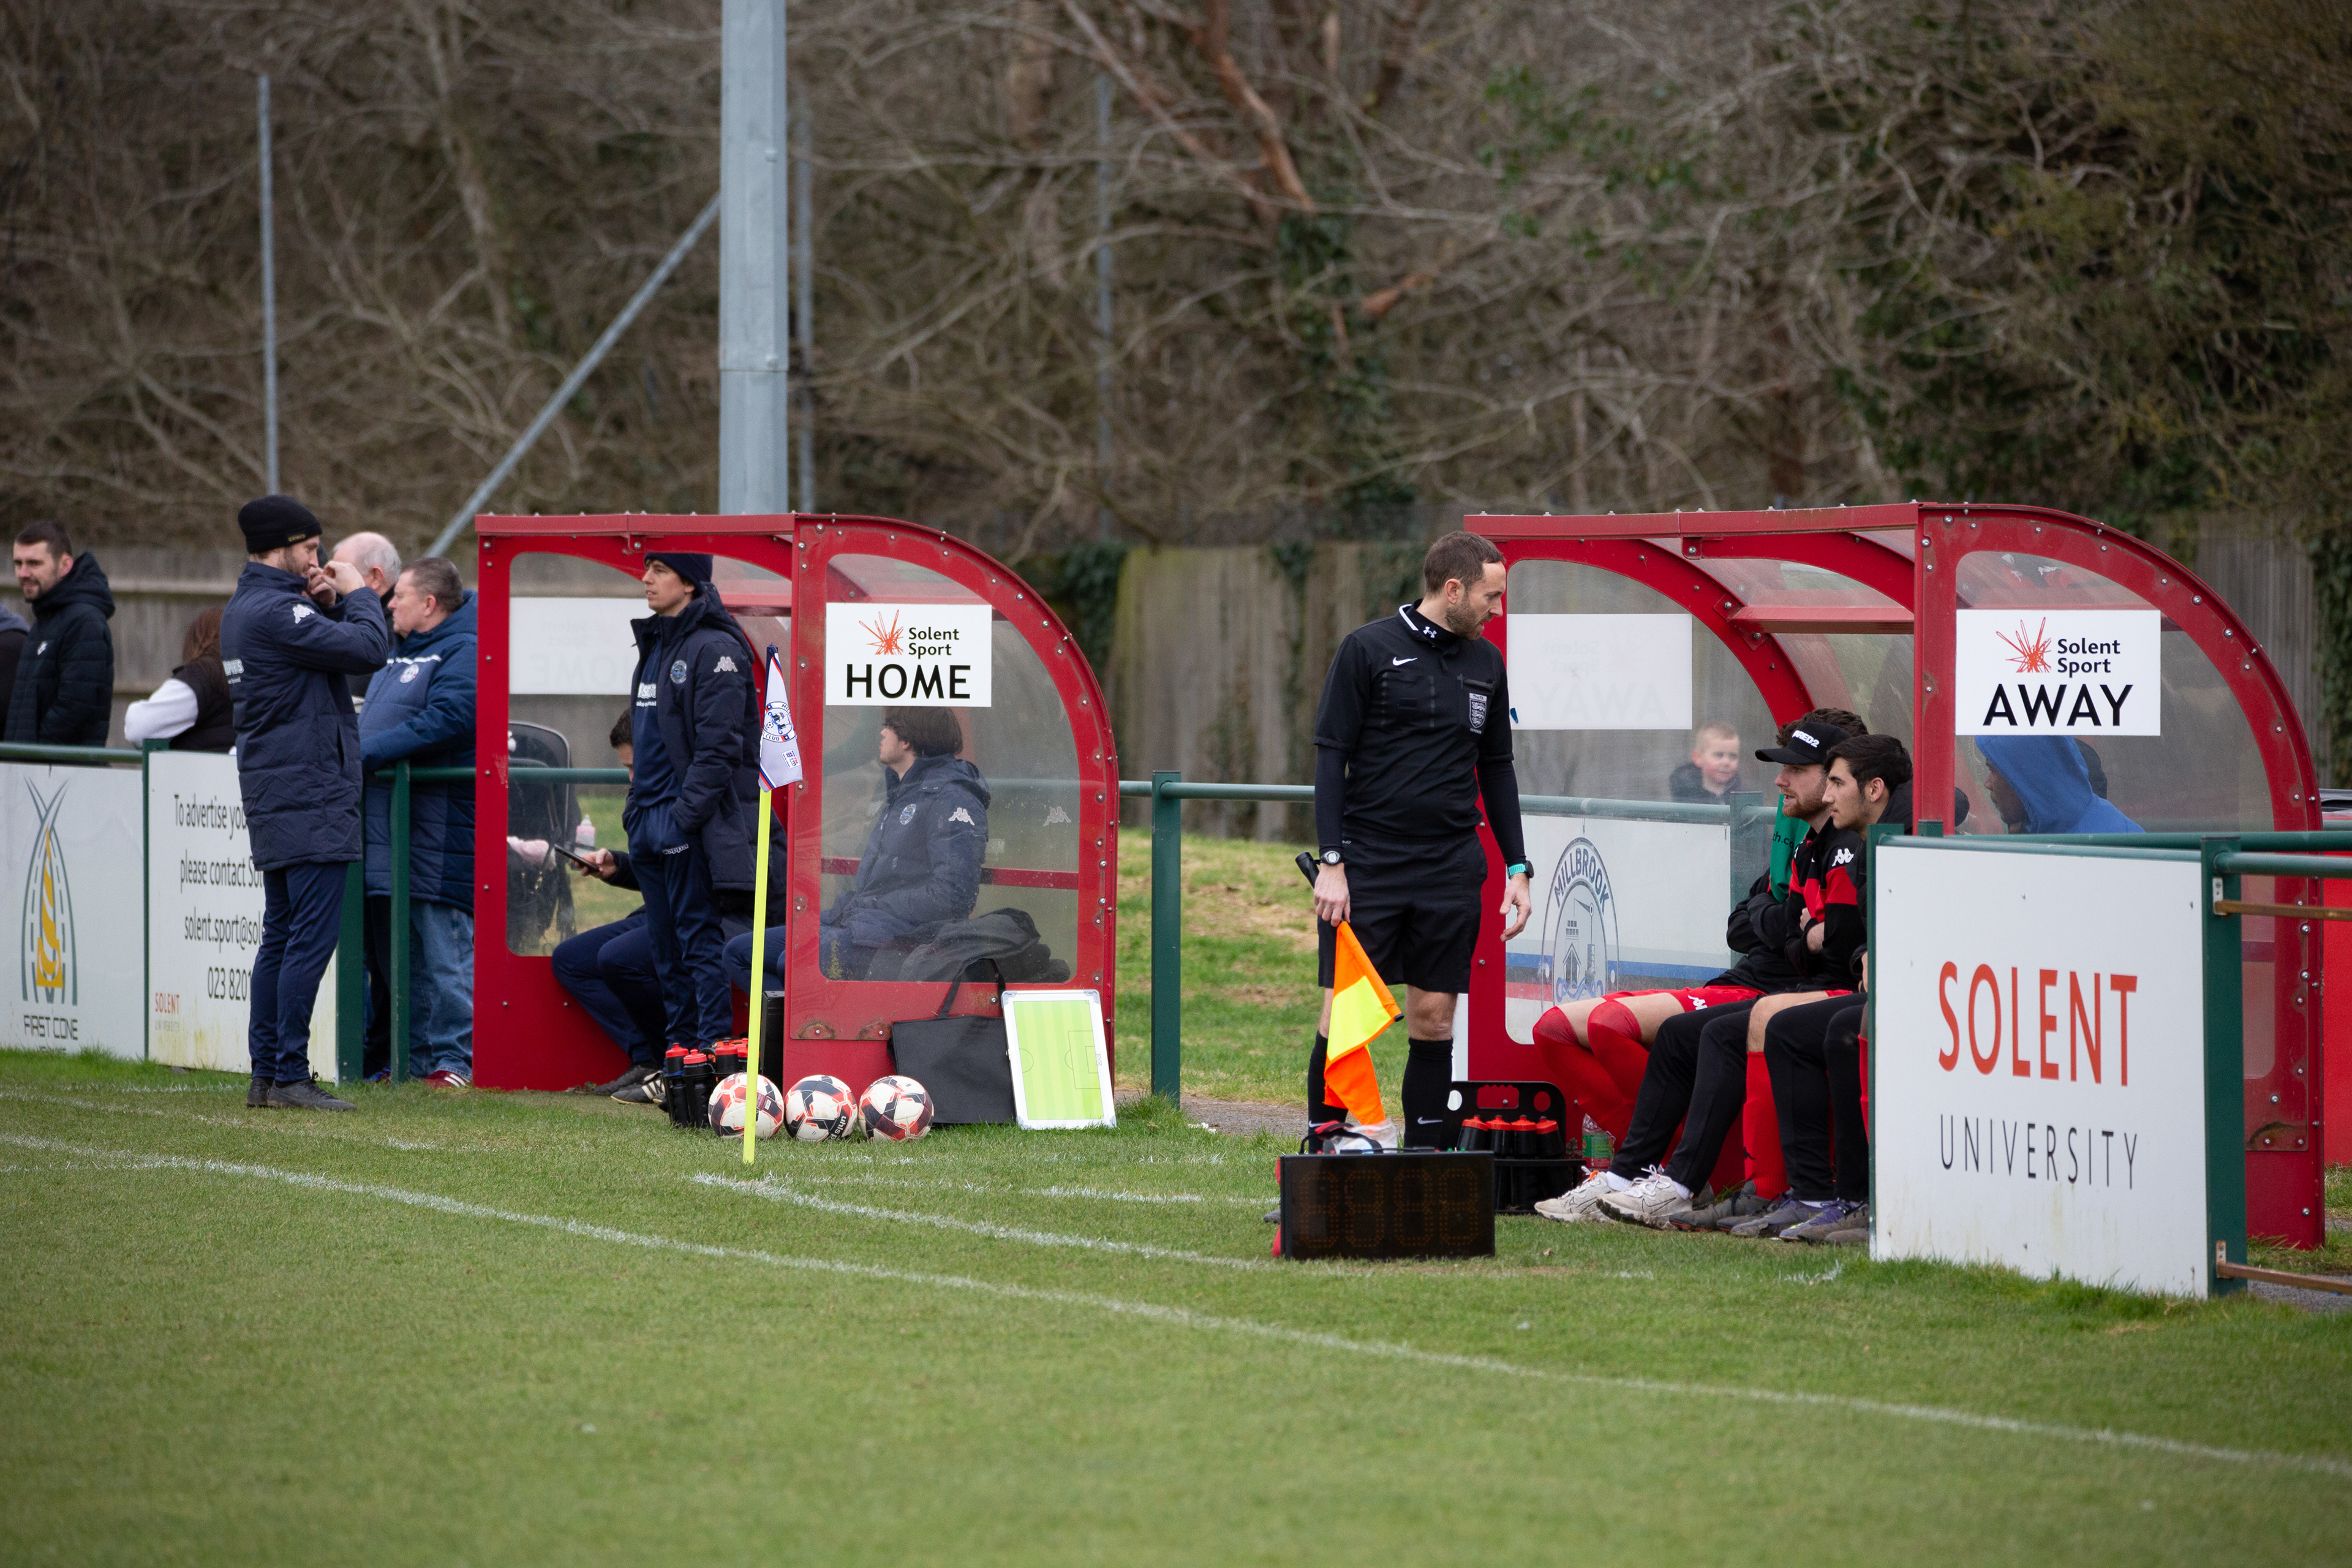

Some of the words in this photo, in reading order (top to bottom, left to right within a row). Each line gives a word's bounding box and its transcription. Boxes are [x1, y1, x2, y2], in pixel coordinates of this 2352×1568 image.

[908, 627, 960, 641] Solent
[2057, 638, 2121, 654] Solent
[908, 643, 952, 660] Sport
[2057, 658, 2111, 678] Sport
[846, 663, 971, 699] HOME
[1982, 684, 2134, 727] AWAY
[175, 794, 184, 826] To
[186, 793, 227, 829] advertise
[662, 843, 689, 855] Kappa
[181, 850, 207, 894] please
[209, 857, 246, 886] contact
[1554, 848, 1610, 916] MILLBROOK
[207, 967, 226, 1000] 023
[155, 992, 179, 1014] SOLENT
[24, 1015, 51, 1038] FIRST
[53, 1017, 78, 1041] CONE
[1938, 961, 2138, 1087] SOLENT
[1940, 1114, 2138, 1190] UNIVERSITY
